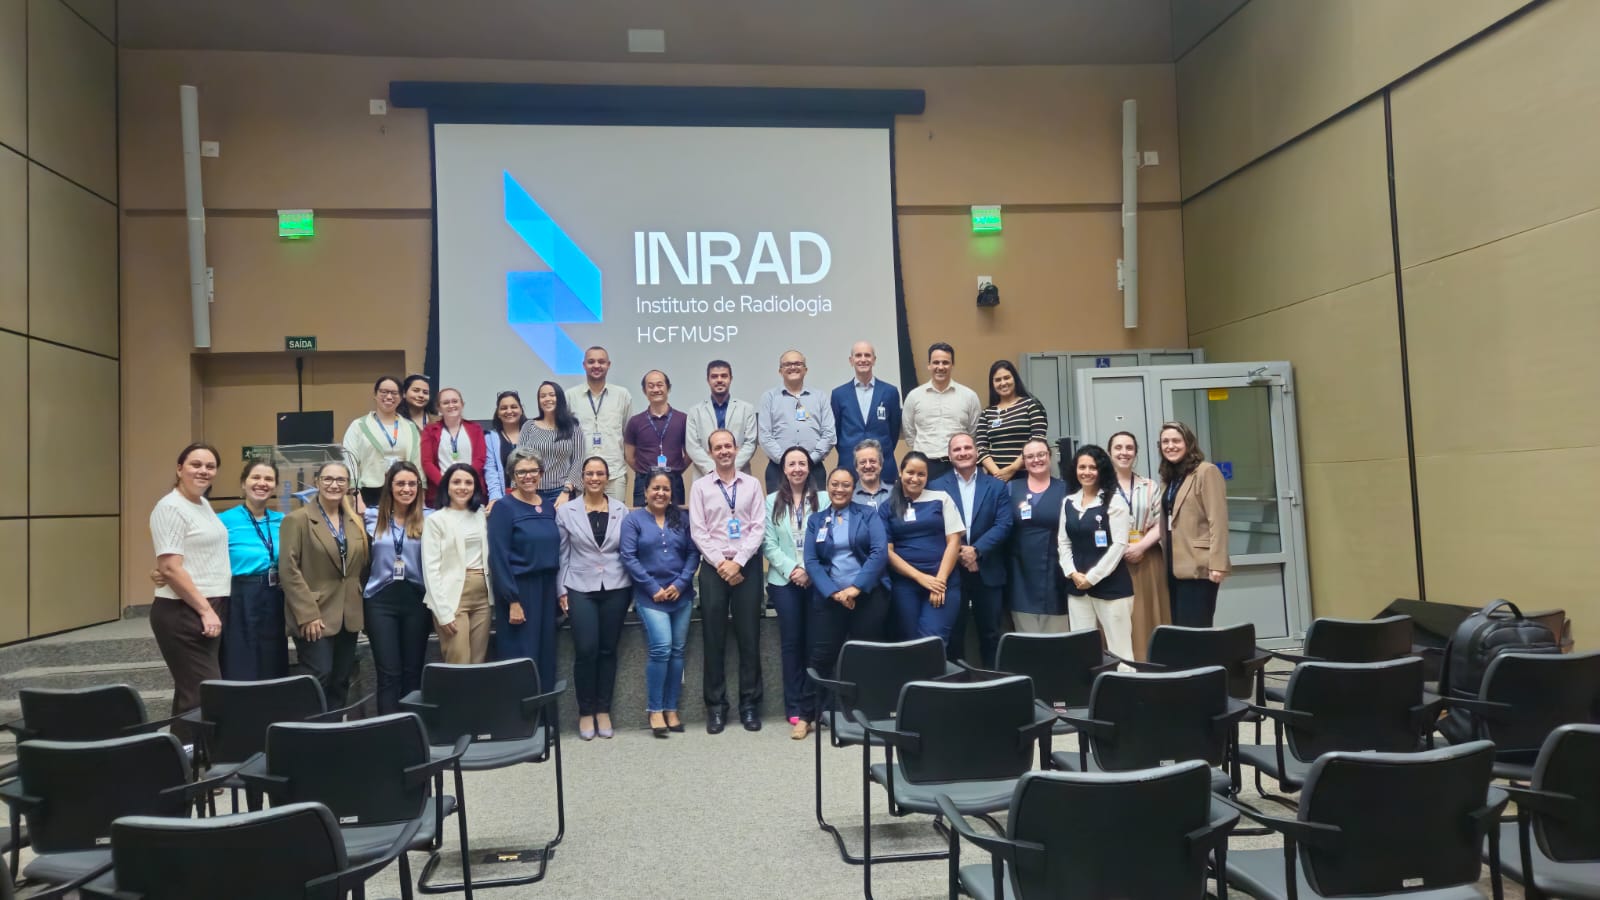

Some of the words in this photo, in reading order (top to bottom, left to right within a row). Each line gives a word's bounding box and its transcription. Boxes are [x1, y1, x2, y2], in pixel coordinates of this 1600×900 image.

[634, 231, 832, 285] INRAD
[636, 296, 708, 313] Instituto
[713, 296, 736, 313] de
[740, 295, 832, 317] Radiologia
[289, 338, 312, 348] SAÍDA
[637, 325, 739, 343] HCFMUSP
